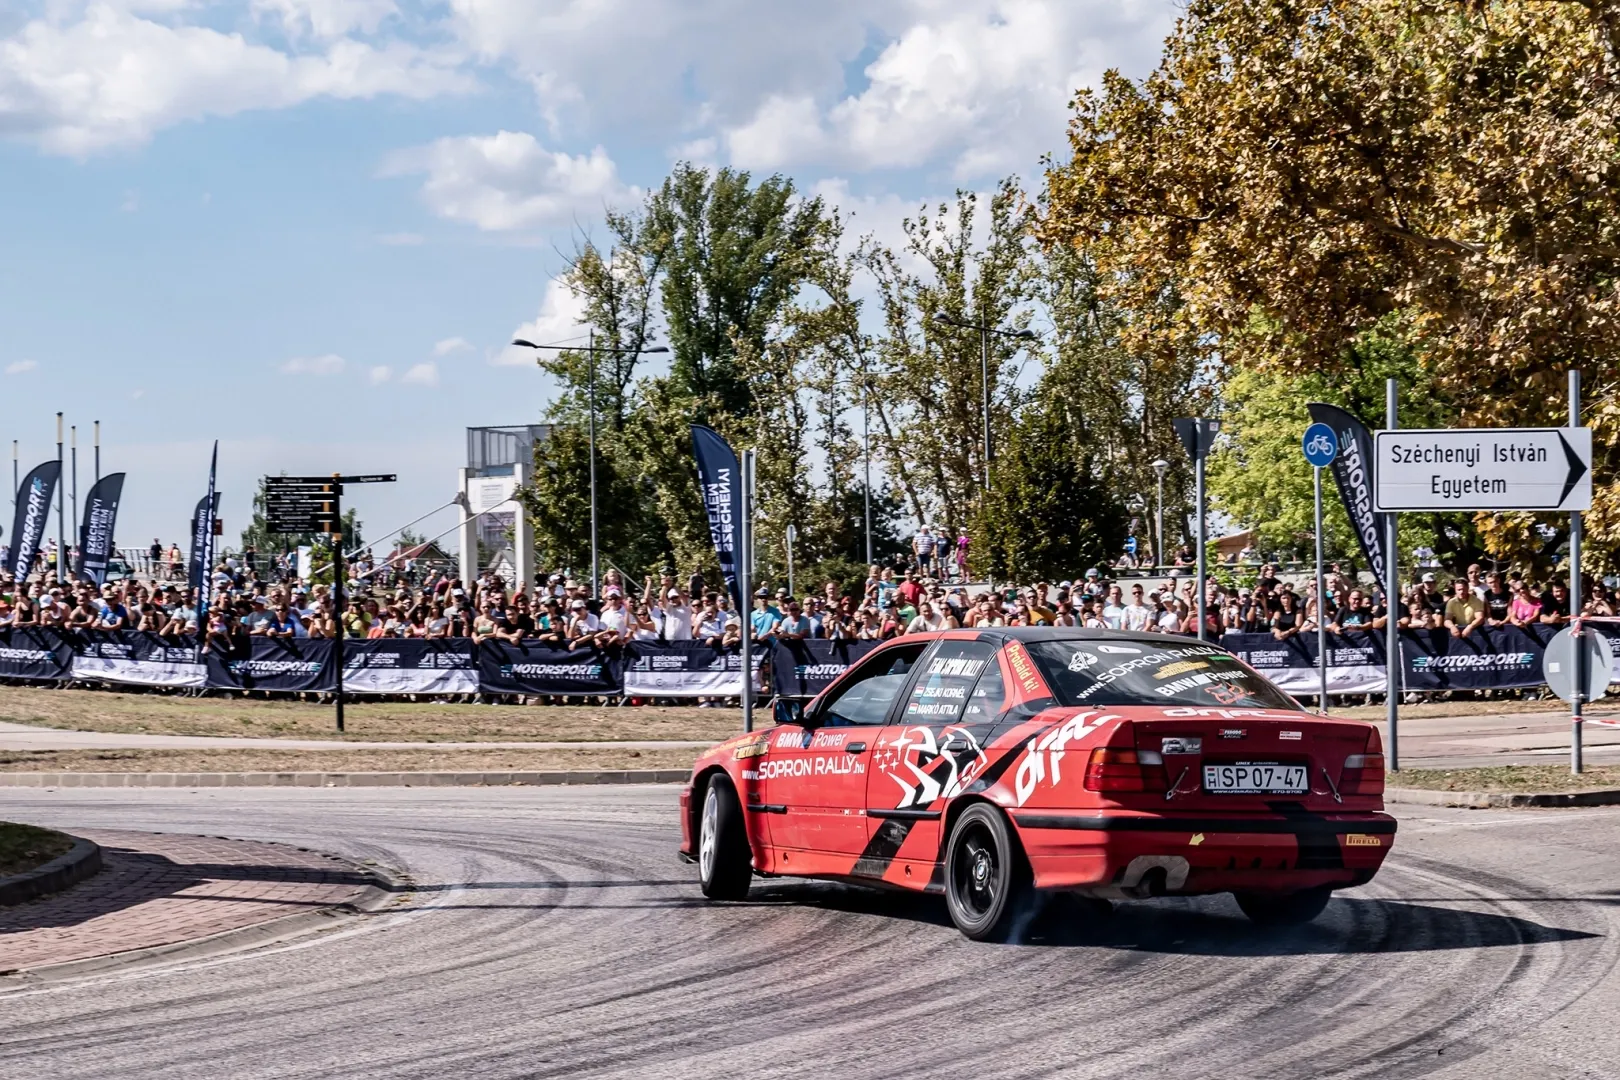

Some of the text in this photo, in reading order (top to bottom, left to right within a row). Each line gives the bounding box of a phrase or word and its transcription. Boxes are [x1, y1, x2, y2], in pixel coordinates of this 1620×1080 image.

[1391, 443, 1547, 468] Széchenyi István
[1431, 475, 1507, 499] Egyetem
[14, 483, 43, 583] MOTORSPORT
[86, 498, 103, 555] SZÉCHENYI
[235, 660, 318, 672] MOTORSPORT
[511, 663, 596, 675] MOTORSPORT
[1006, 643, 1040, 694] Próbáld ki!
[1424, 652, 1526, 668] MOTORSPORT
[1076, 652, 1171, 699] www.SOPRON
[1154, 676, 1199, 697] BMW
[1205, 669, 1249, 683] Power
[938, 704, 959, 715] ATTILA
[776, 731, 848, 748] BMW Power
[742, 754, 865, 780] www.SOPRON RALLY.hu
[1208, 767, 1305, 788] H SP 07-47
[1345, 833, 1381, 846] PIRELLI
